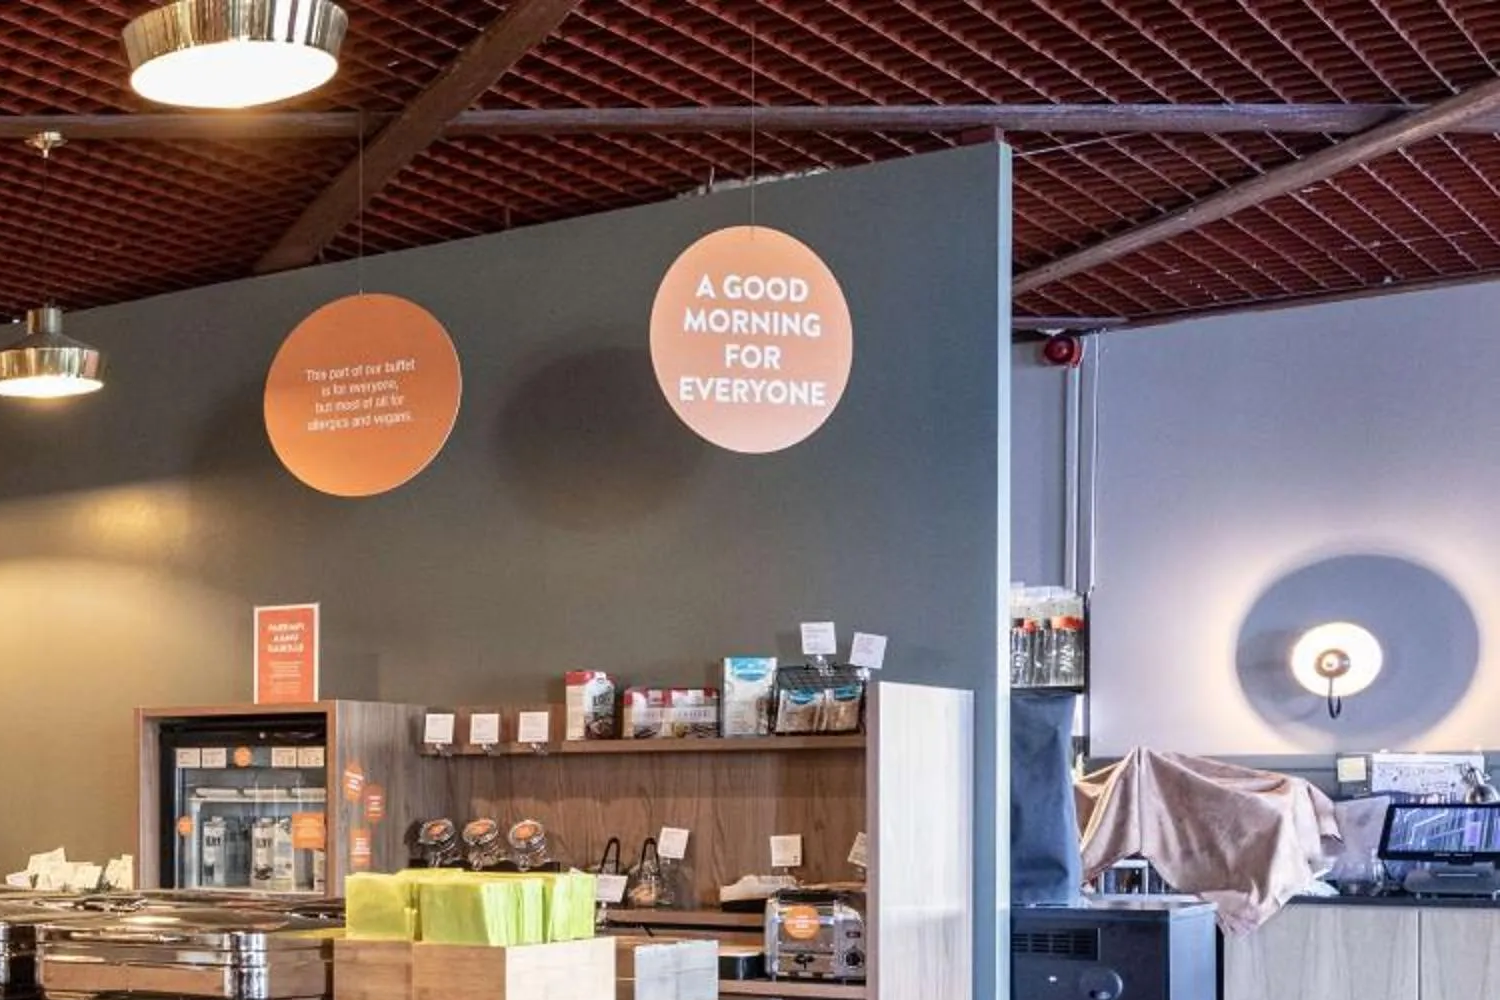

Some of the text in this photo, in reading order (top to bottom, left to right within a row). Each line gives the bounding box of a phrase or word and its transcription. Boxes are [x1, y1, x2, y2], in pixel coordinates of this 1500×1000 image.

[695, 273, 809, 302] A GOOD
[683, 306, 821, 338] MORNING
[725, 343, 781, 369] FOR
[306, 358, 416, 382] This part of our buffet
[678, 375, 827, 406] EVERYONE
[315, 402, 333, 414] but
[335, 399, 360, 412] most
[362, 397, 374, 409] of
[391, 394, 405, 406] for
[351, 415, 371, 427] and
